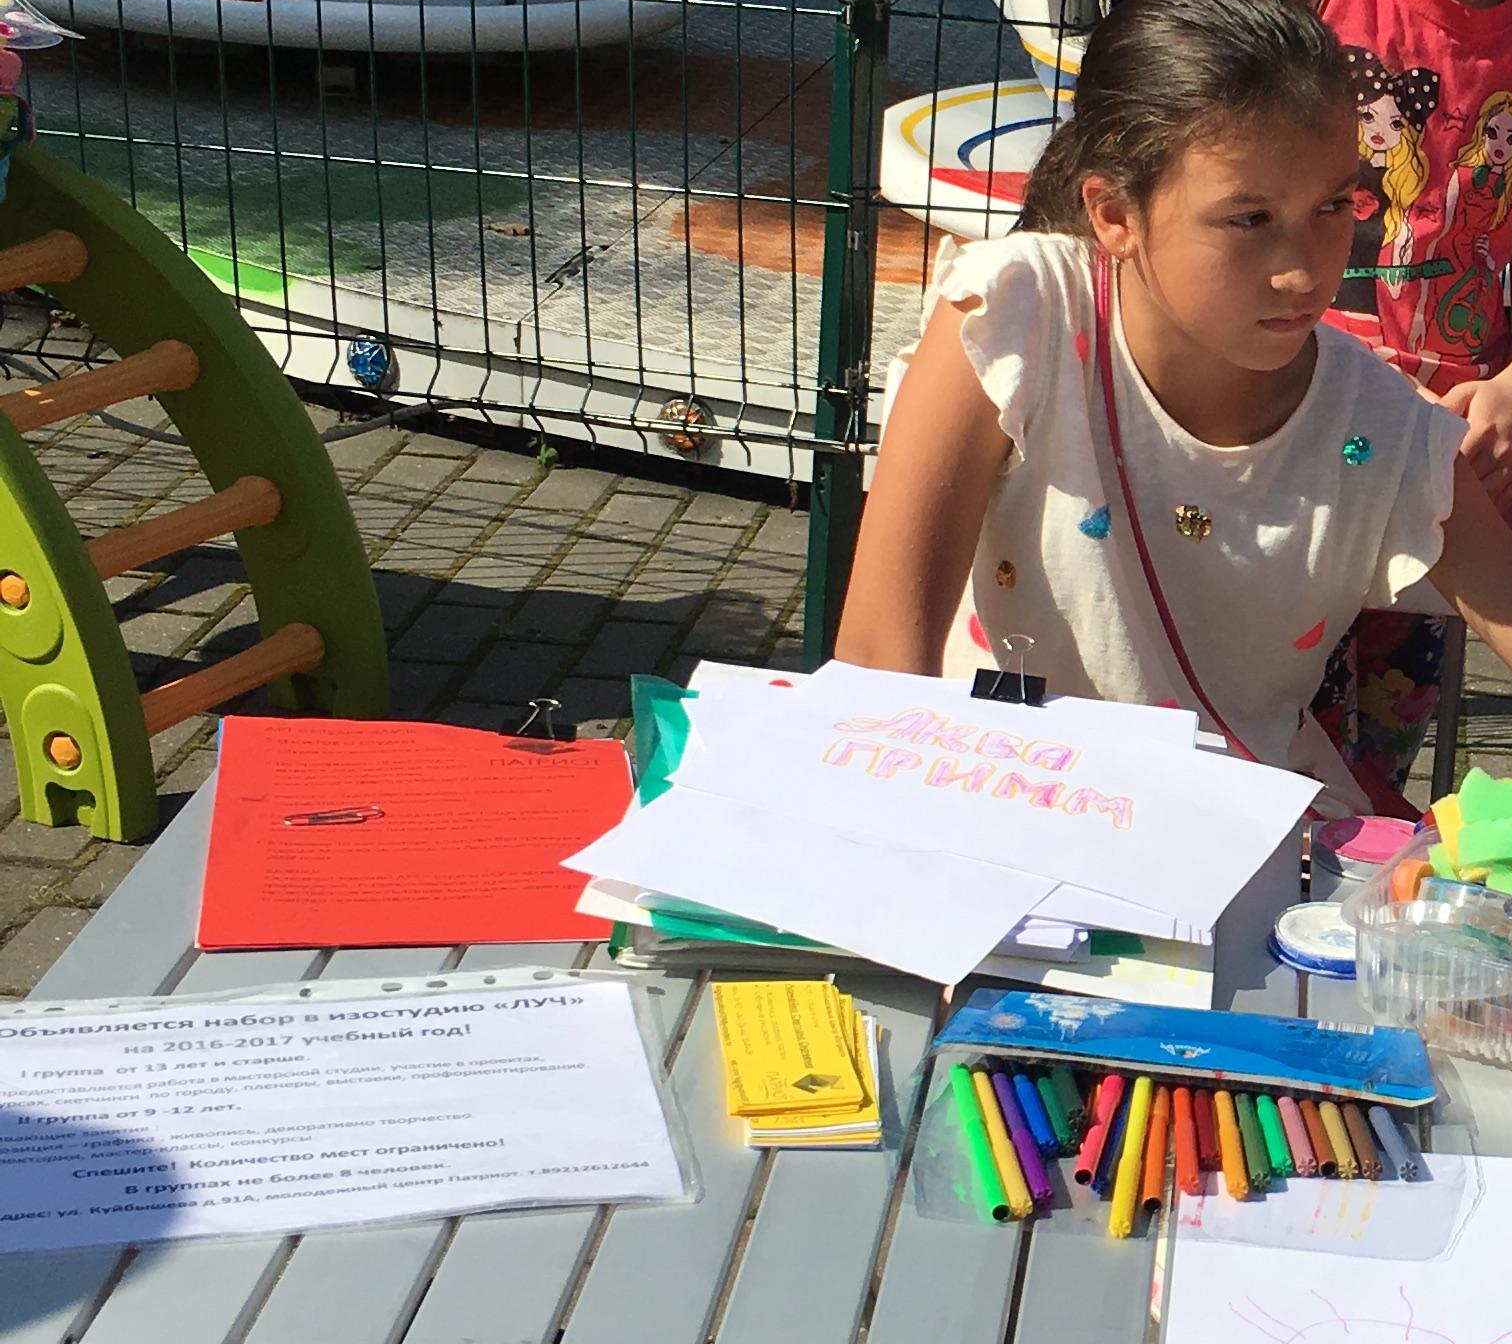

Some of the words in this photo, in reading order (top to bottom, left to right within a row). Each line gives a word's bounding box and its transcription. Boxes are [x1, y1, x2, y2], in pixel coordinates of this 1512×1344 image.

[489, 757, 600, 767] ПАТРИОТ
[0, 1019, 194, 1039] Объявляется
[204, 1013, 295, 1028] набор
[304, 1013, 320, 1022] в
[329, 1003, 486, 1021] изостудию
[494, 995, 585, 1010] «ЛУЧ»
[124, 1045, 155, 1055] на
[163, 1036, 294, 1051] 2016-2017
[302, 1028, 414, 1046] учебный
[422, 1023, 472, 1038] год!
[33, 1067, 104, 1080] группа
[116, 1065, 138, 1075] от
[144, 1063, 168, 1073] 13
[173, 1060, 207, 1071] лет
[232, 1054, 311, 1067] старше.
[147, 1077, 205, 1091] работа
[224, 1067, 321, 1082] мастерской
[390, 1059, 452, 1072] участие
[36, 1113, 110, 1127] группа
[200, 1103, 242, 1113] лет.
[379, 1112, 472, 1125] творчество
[72, 1161, 178, 1179] Спешите!
[189, 1153, 315, 1170] Количество
[319, 1148, 370, 1160] мест
[375, 1138, 506, 1157] ограничено!
[230, 1136, 312, 1149] конкурсы
[144, 1179, 232, 1196] группах
[237, 1176, 265, 1186] не
[269, 1171, 334, 1184] более
[357, 1160, 452, 1175] человек.
[89, 1199, 199, 1217] Куйбышева
[265, 1180, 388, 1202] молодежный
[392, 1177, 445, 1190] центр
